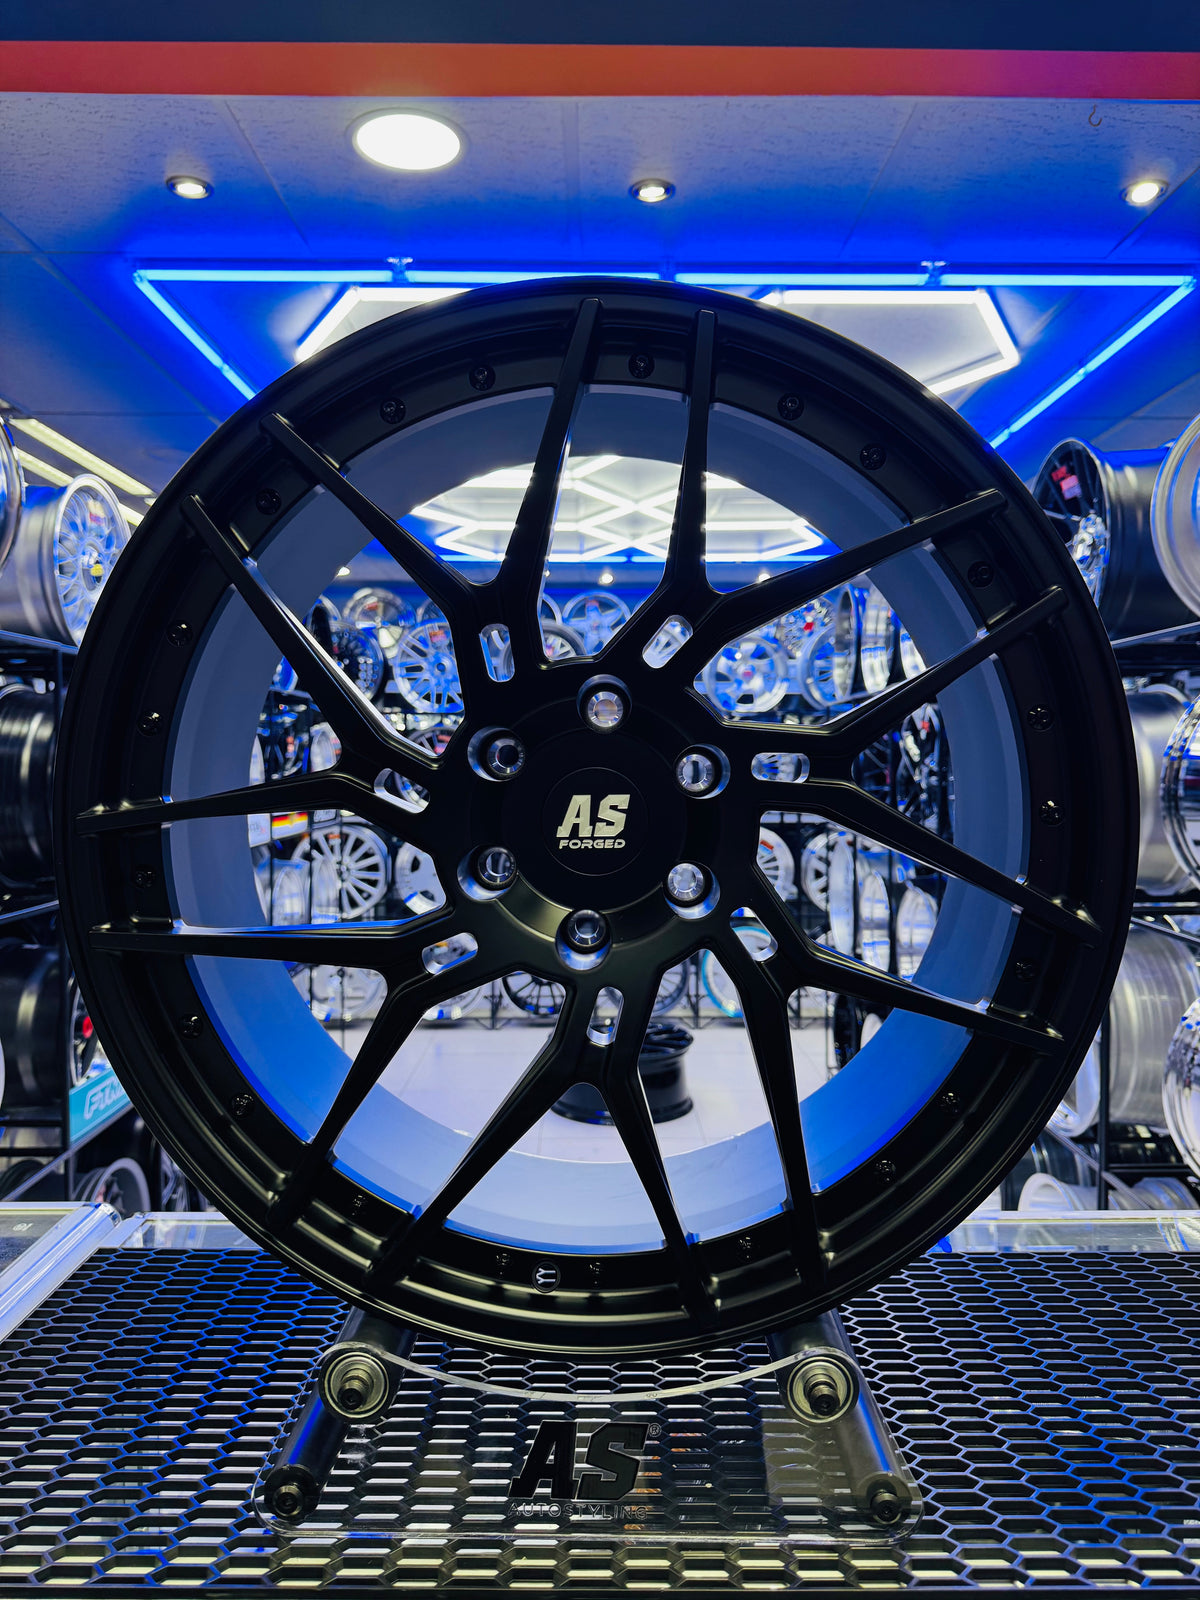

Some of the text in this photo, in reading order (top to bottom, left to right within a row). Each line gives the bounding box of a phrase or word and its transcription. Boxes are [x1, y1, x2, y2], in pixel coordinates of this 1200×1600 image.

[556, 794, 630, 837] AS
[558, 839, 626, 849] FORGED
[508, 1502, 648, 1520] AUTOSTYLING
